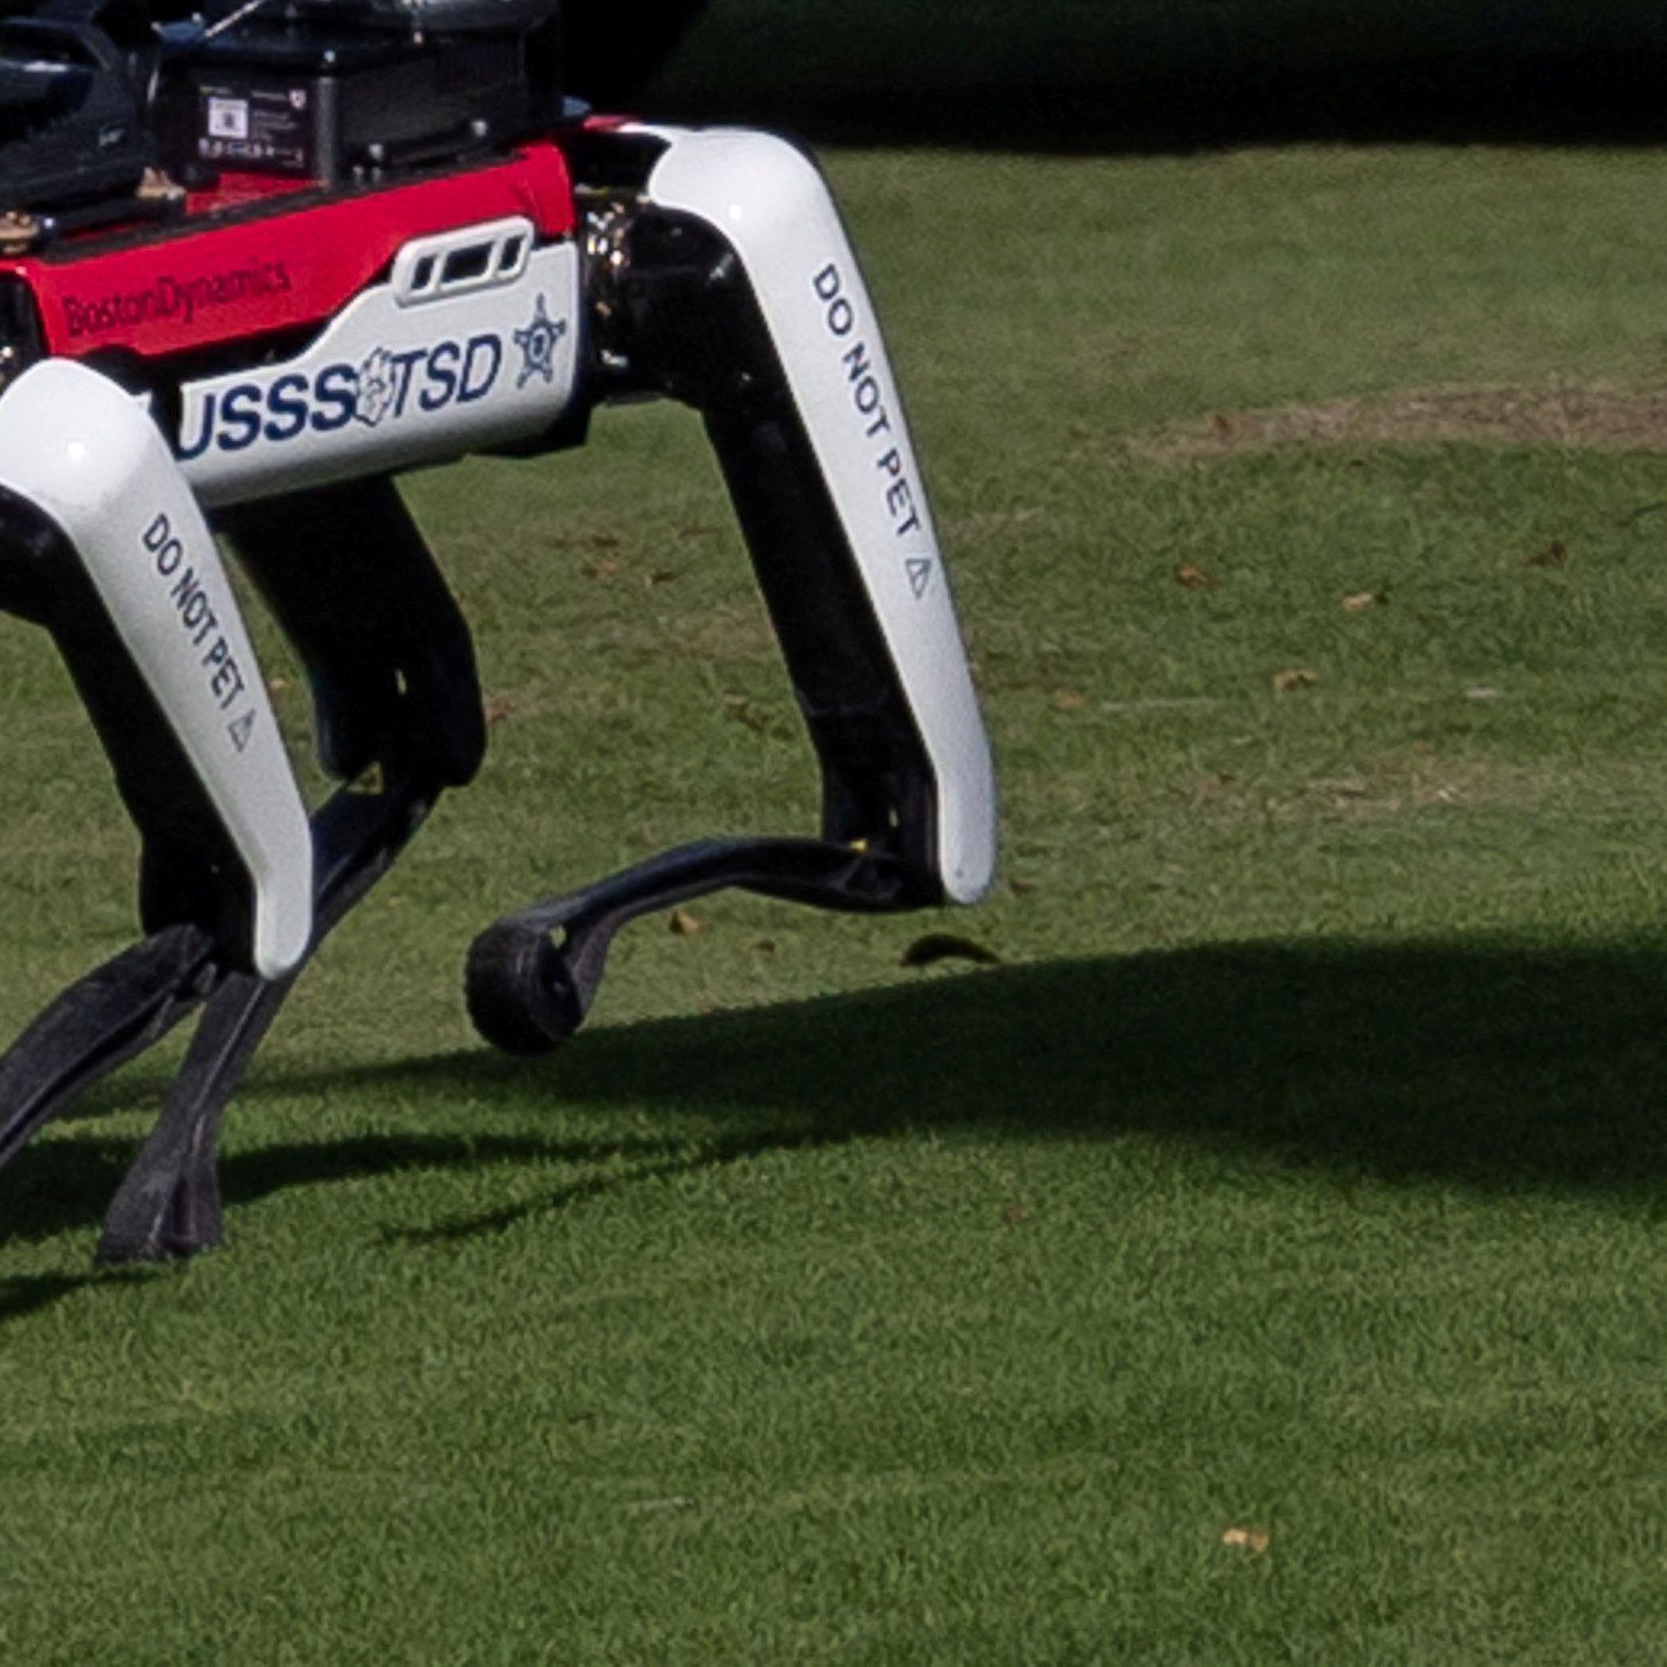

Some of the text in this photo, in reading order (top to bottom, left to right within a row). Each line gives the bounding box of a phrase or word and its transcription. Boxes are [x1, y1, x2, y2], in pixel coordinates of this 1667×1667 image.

[391, 334, 503, 418] TSD
[813, 263, 922, 537] DO NOT PET
[141, 512, 245, 711] DO NOT PET
